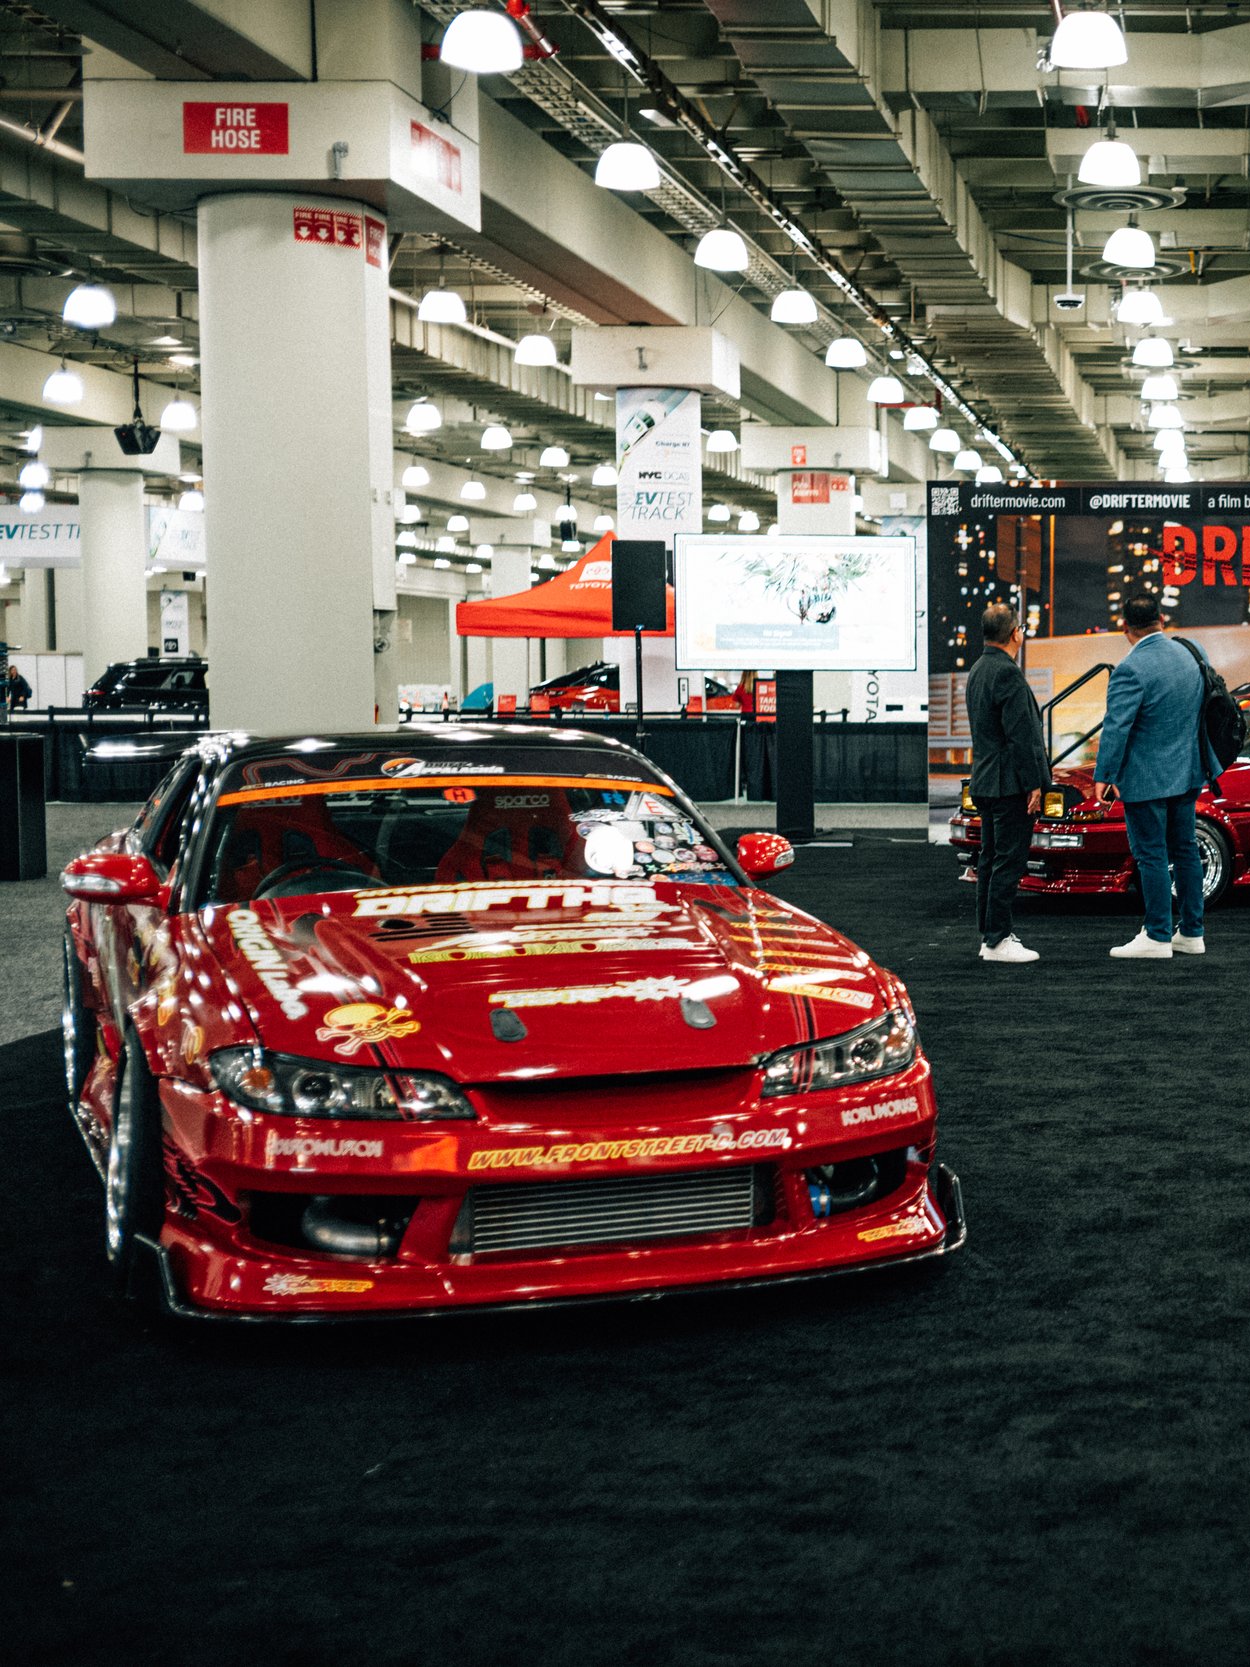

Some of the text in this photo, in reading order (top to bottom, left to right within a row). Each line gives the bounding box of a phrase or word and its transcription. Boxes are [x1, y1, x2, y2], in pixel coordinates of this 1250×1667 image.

[215, 108, 256, 127] FIRE
[211, 130, 260, 149] HOSE
[295, 211, 313, 219] FIRE
[638, 471, 662, 480] NYC
[970, 493, 1066, 509] driftermovie.com
[1089, 494, 1191, 509] @DRIFTERMOVIE
[1207, 497, 1215, 509] a
[1217, 494, 1242, 509] film
[631, 506, 686, 521] TRACK
[264, 778, 306, 788] RACING
[494, 794, 550, 808] sparco
[352, 885, 657, 917] DRIFTHQ
[467, 1127, 790, 1170] WWW.FRONTSTREET-D.COM
